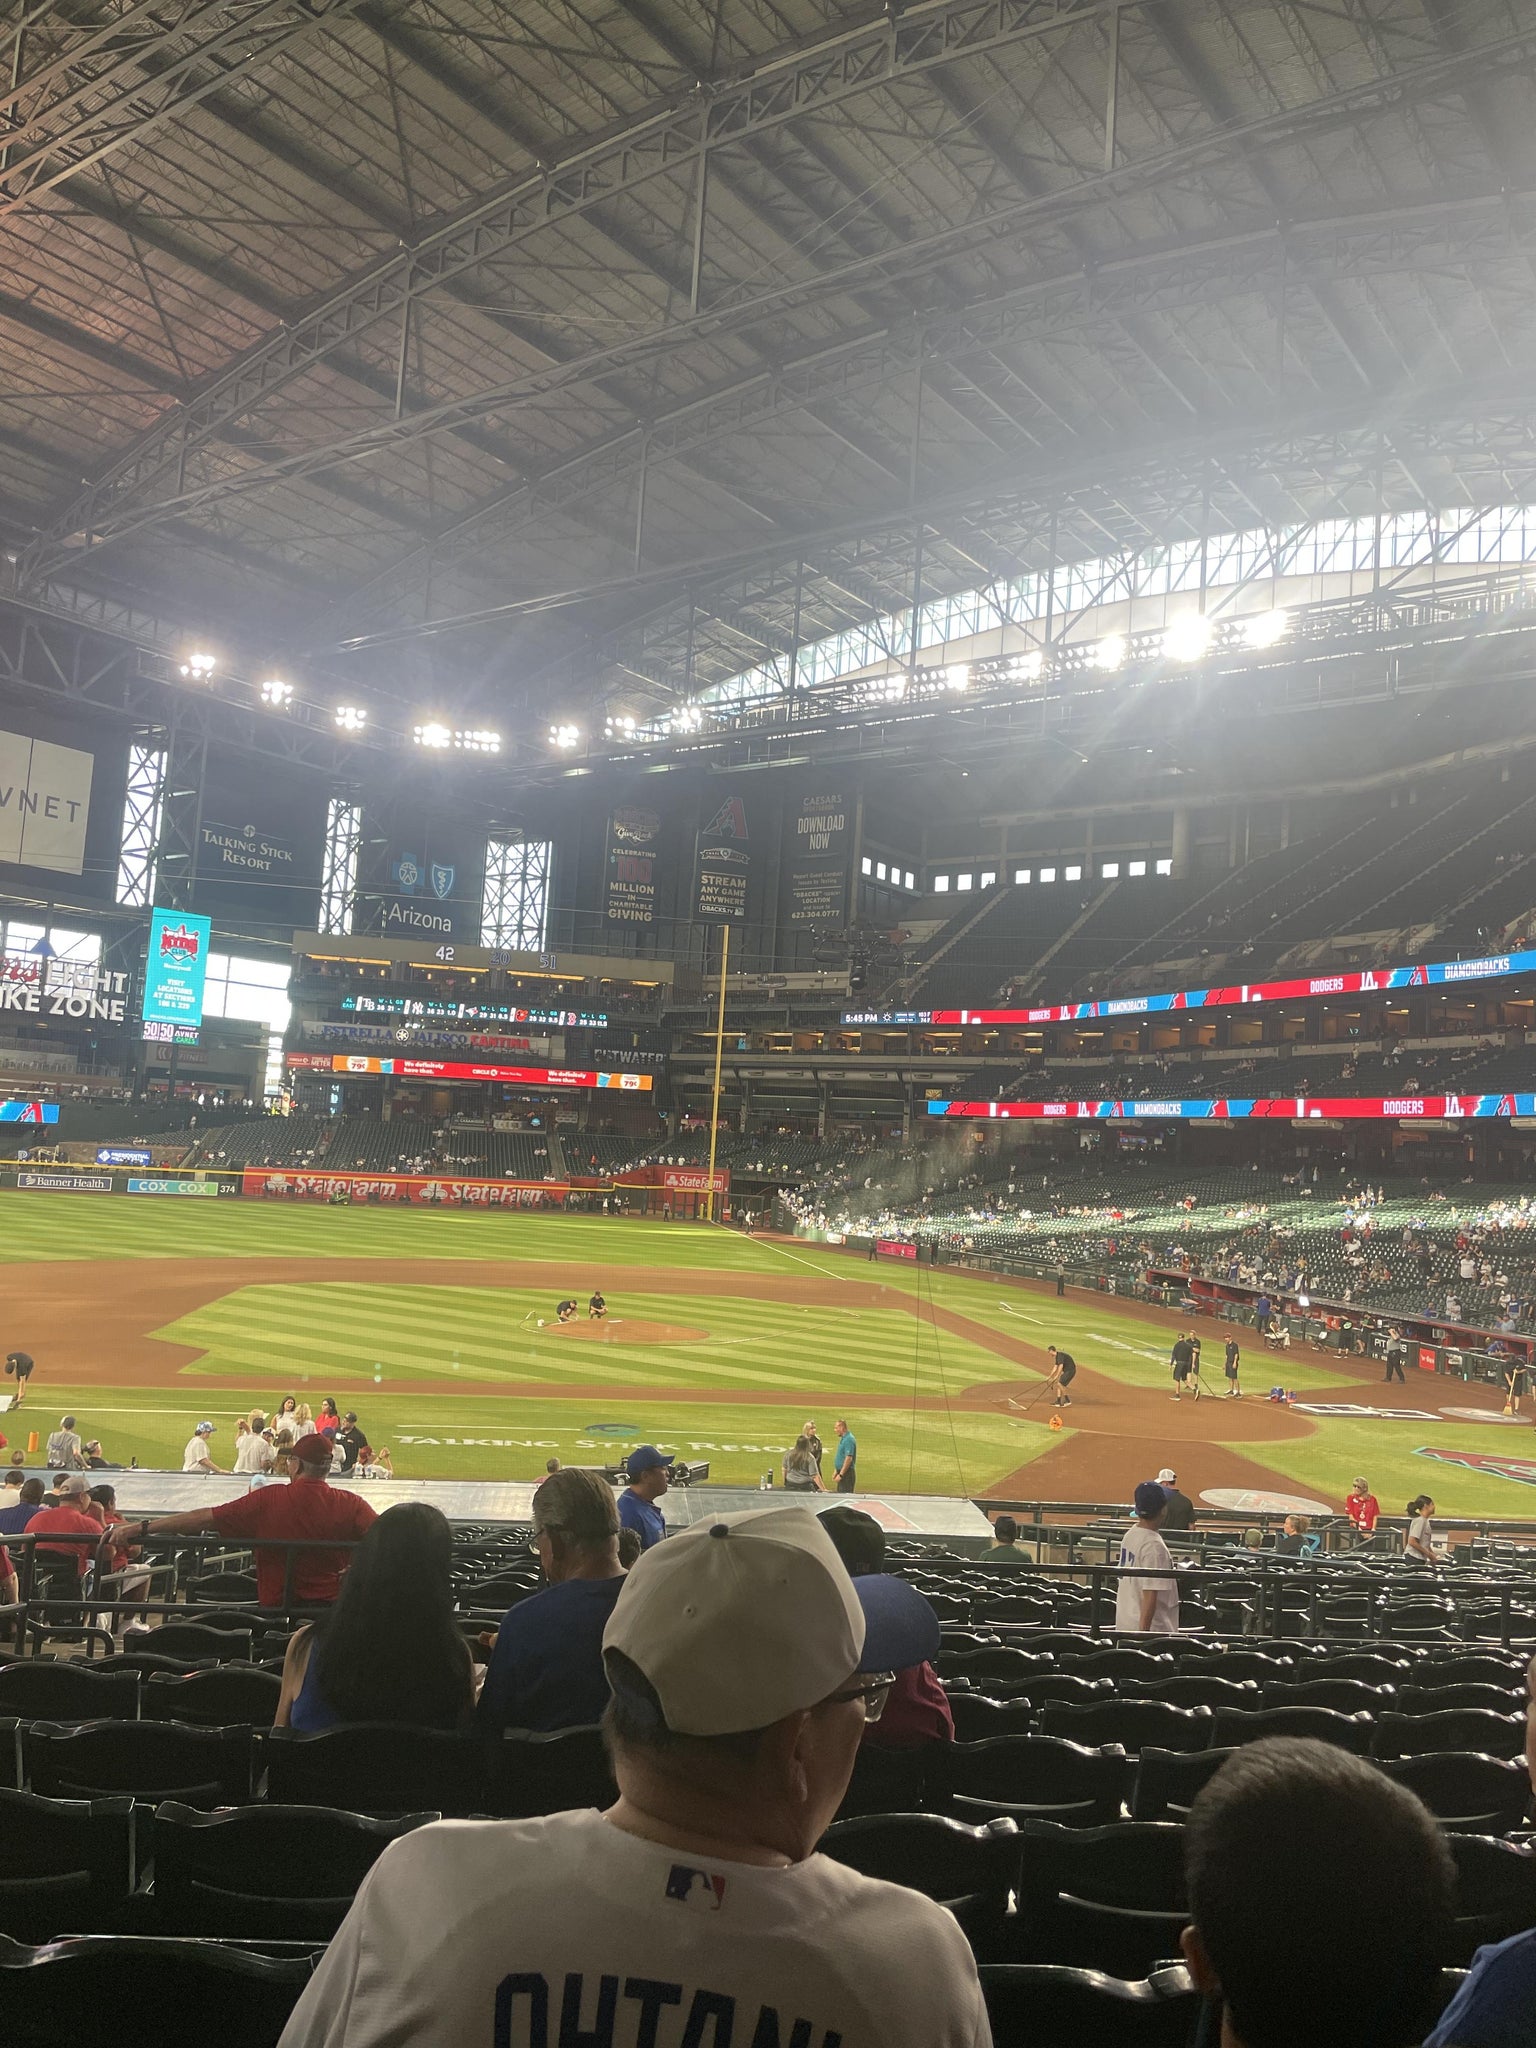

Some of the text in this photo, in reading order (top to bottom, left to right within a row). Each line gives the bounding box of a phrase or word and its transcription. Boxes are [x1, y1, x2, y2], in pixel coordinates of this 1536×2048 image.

[797, 814, 845, 834] DOWNLOAD
[201, 828, 293, 862] TALKING STICK
[809, 832, 830, 850] NOW
[222, 849, 272, 871] RESORT
[612, 848, 656, 858] CELEBRATING
[610, 882, 655, 895] MILLION
[701, 875, 746, 889] STREAM
[627, 894, 637, 902] IN
[700, 886, 746, 898] ANY GAME
[609, 900, 653, 911] CHARITABLE
[700, 895, 745, 906] ANYWHERE
[388, 902, 452, 933] Arizona
[608, 908, 653, 922] GIVING
[435, 946, 455, 961] 42
[489, 951, 511, 966] 20
[538, 954, 557, 970] 51
[1443, 957, 1510, 979] DIAMONDBACKS
[46, 960, 128, 994] LIGHT
[1309, 978, 1343, 994] DODGERS
[48, 994, 125, 1021] ZONE
[1107, 999, 1148, 1014] DIAMONDBACKS
[845, 1013, 878, 1022] 5:45 PM
[1028, 1009, 1051, 1021] DODGERS
[174, 1030, 199, 1038] AVNET
[321, 1024, 530, 1049] ESTRELLA JALISCO CANTINA
[416, 1062, 444, 1070] definitely
[558, 1071, 586, 1079] definitely
[1043, 1104, 1067, 1115] DODGERS
[1134, 1103, 1182, 1115] DIAMONDBACKS
[1383, 1100, 1424, 1114] DODGERS
[37, 1176, 105, 1189] Banner Health
[138, 1182, 207, 1194] COX COX
[295, 1176, 397, 1197] State Farm
[678, 1175, 701, 1188] State
[220, 1185, 235, 1194] 374
[451, 1181, 543, 1203] State Farm
[393, 1435, 560, 1449] TALKING
[575, 1438, 680, 1451] STICK
[494, 1972, 842, 2048] OHT
